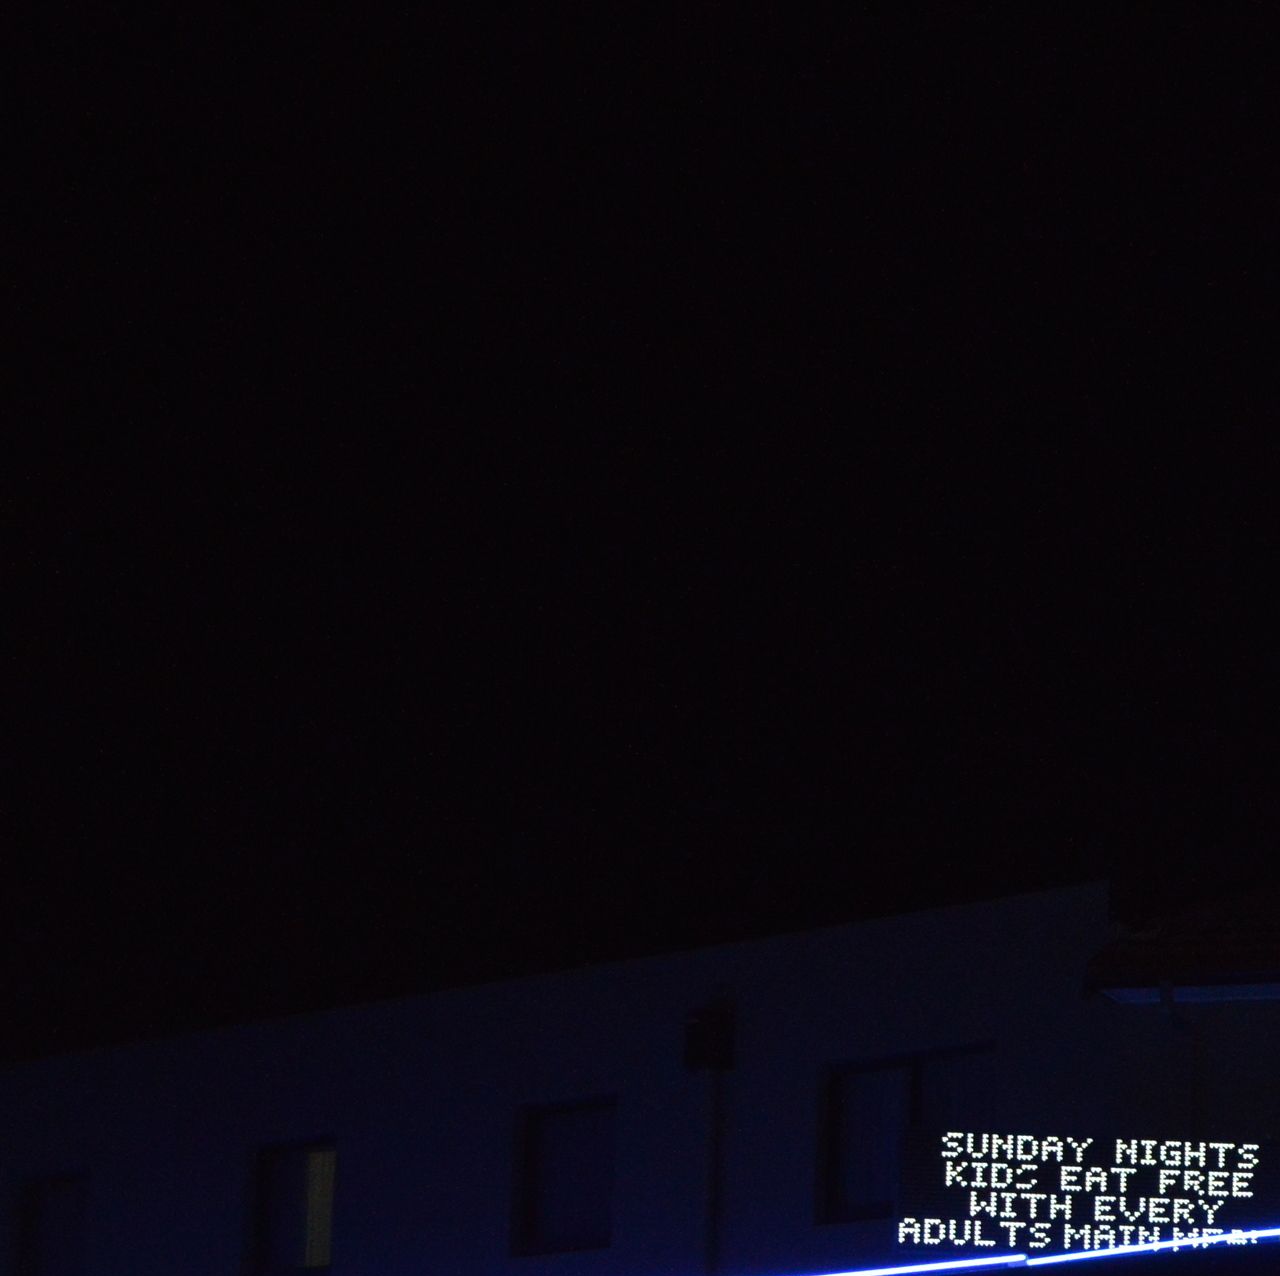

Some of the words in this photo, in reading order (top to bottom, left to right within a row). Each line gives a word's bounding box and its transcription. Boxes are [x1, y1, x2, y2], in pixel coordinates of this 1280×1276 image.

[941, 1131, 1094, 1164] SUNDAY
[1115, 1138, 1260, 1170] NIGHTS
[945, 1161, 1038, 1190] KIDS
[1060, 1165, 1138, 1194] EAT
[1159, 1168, 1254, 1198] FREE
[969, 1191, 1073, 1220] WITH
[1093, 1195, 1225, 1225] EVERY
[898, 1217, 1052, 1248] ADULTS
[1063, 1223, 1161, 1252] MAIN
